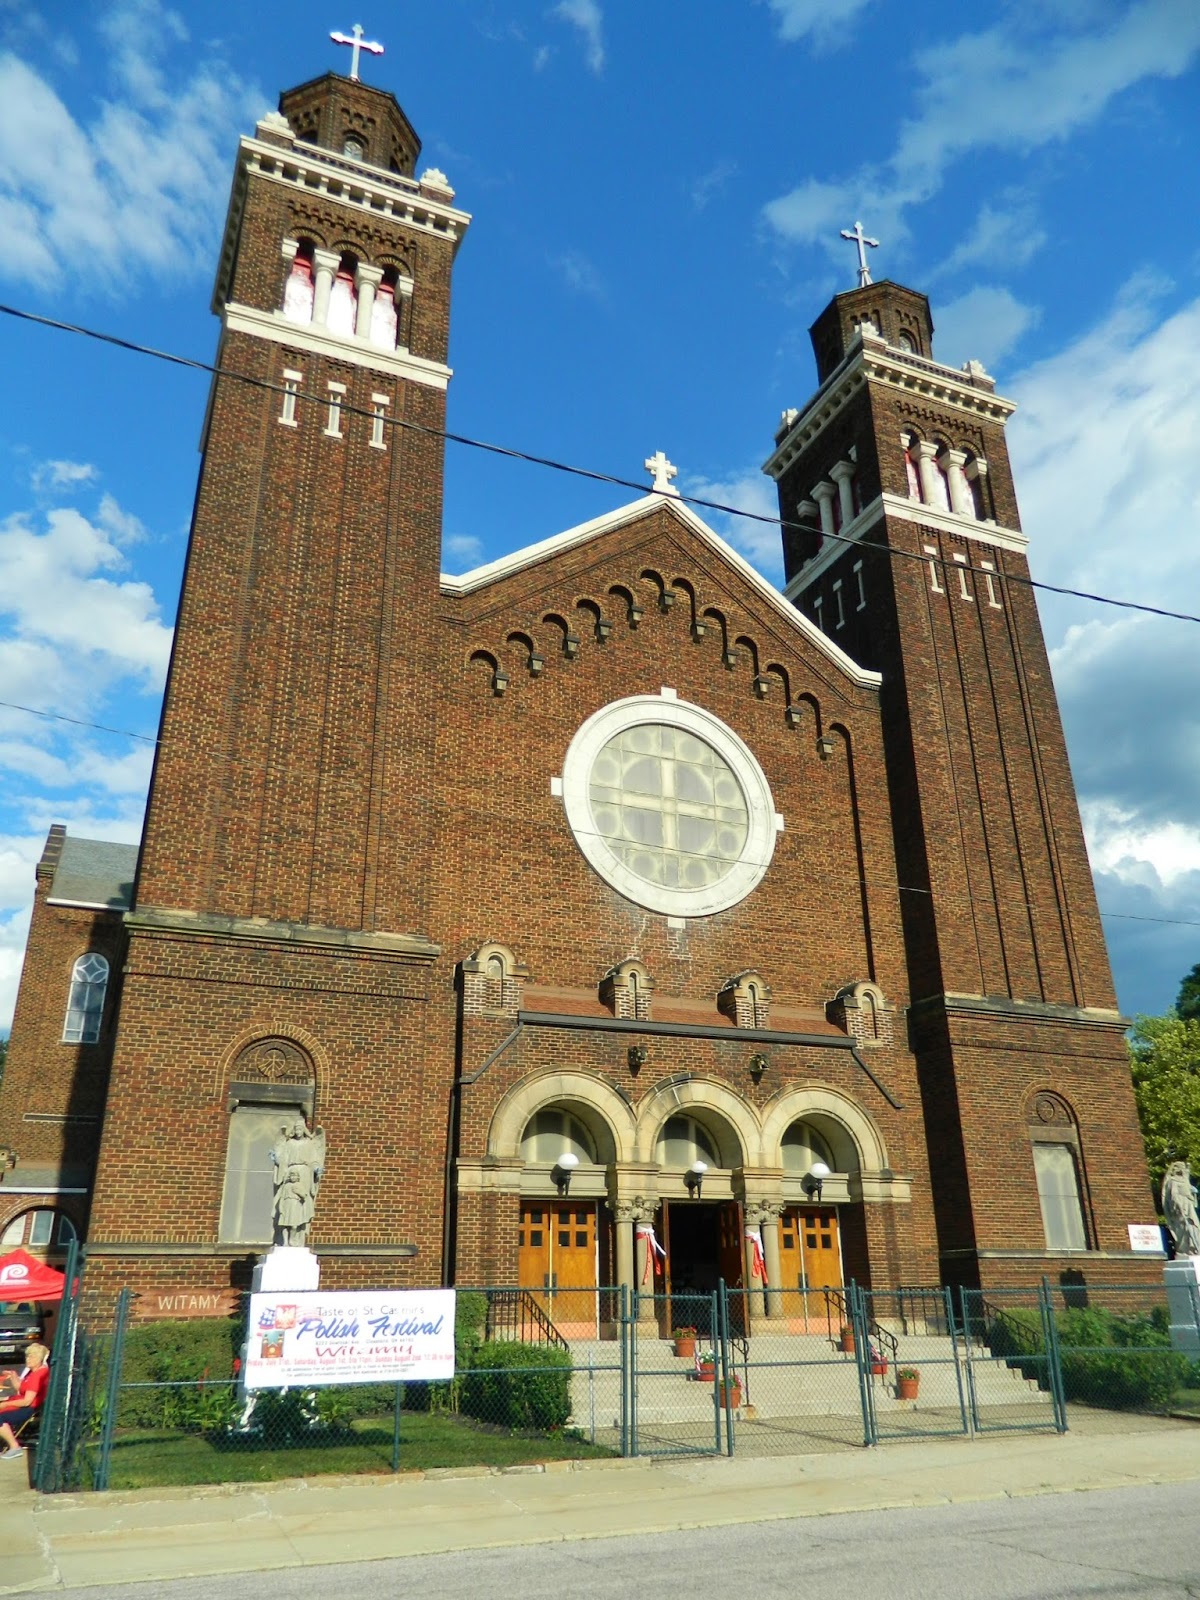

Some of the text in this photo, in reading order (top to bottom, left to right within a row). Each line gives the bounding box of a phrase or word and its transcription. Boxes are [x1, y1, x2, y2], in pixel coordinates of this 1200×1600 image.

[158, 1294, 221, 1310] WITAMY
[316, 1306, 344, 1317] Taste
[296, 1315, 443, 1340] Polish Festival
